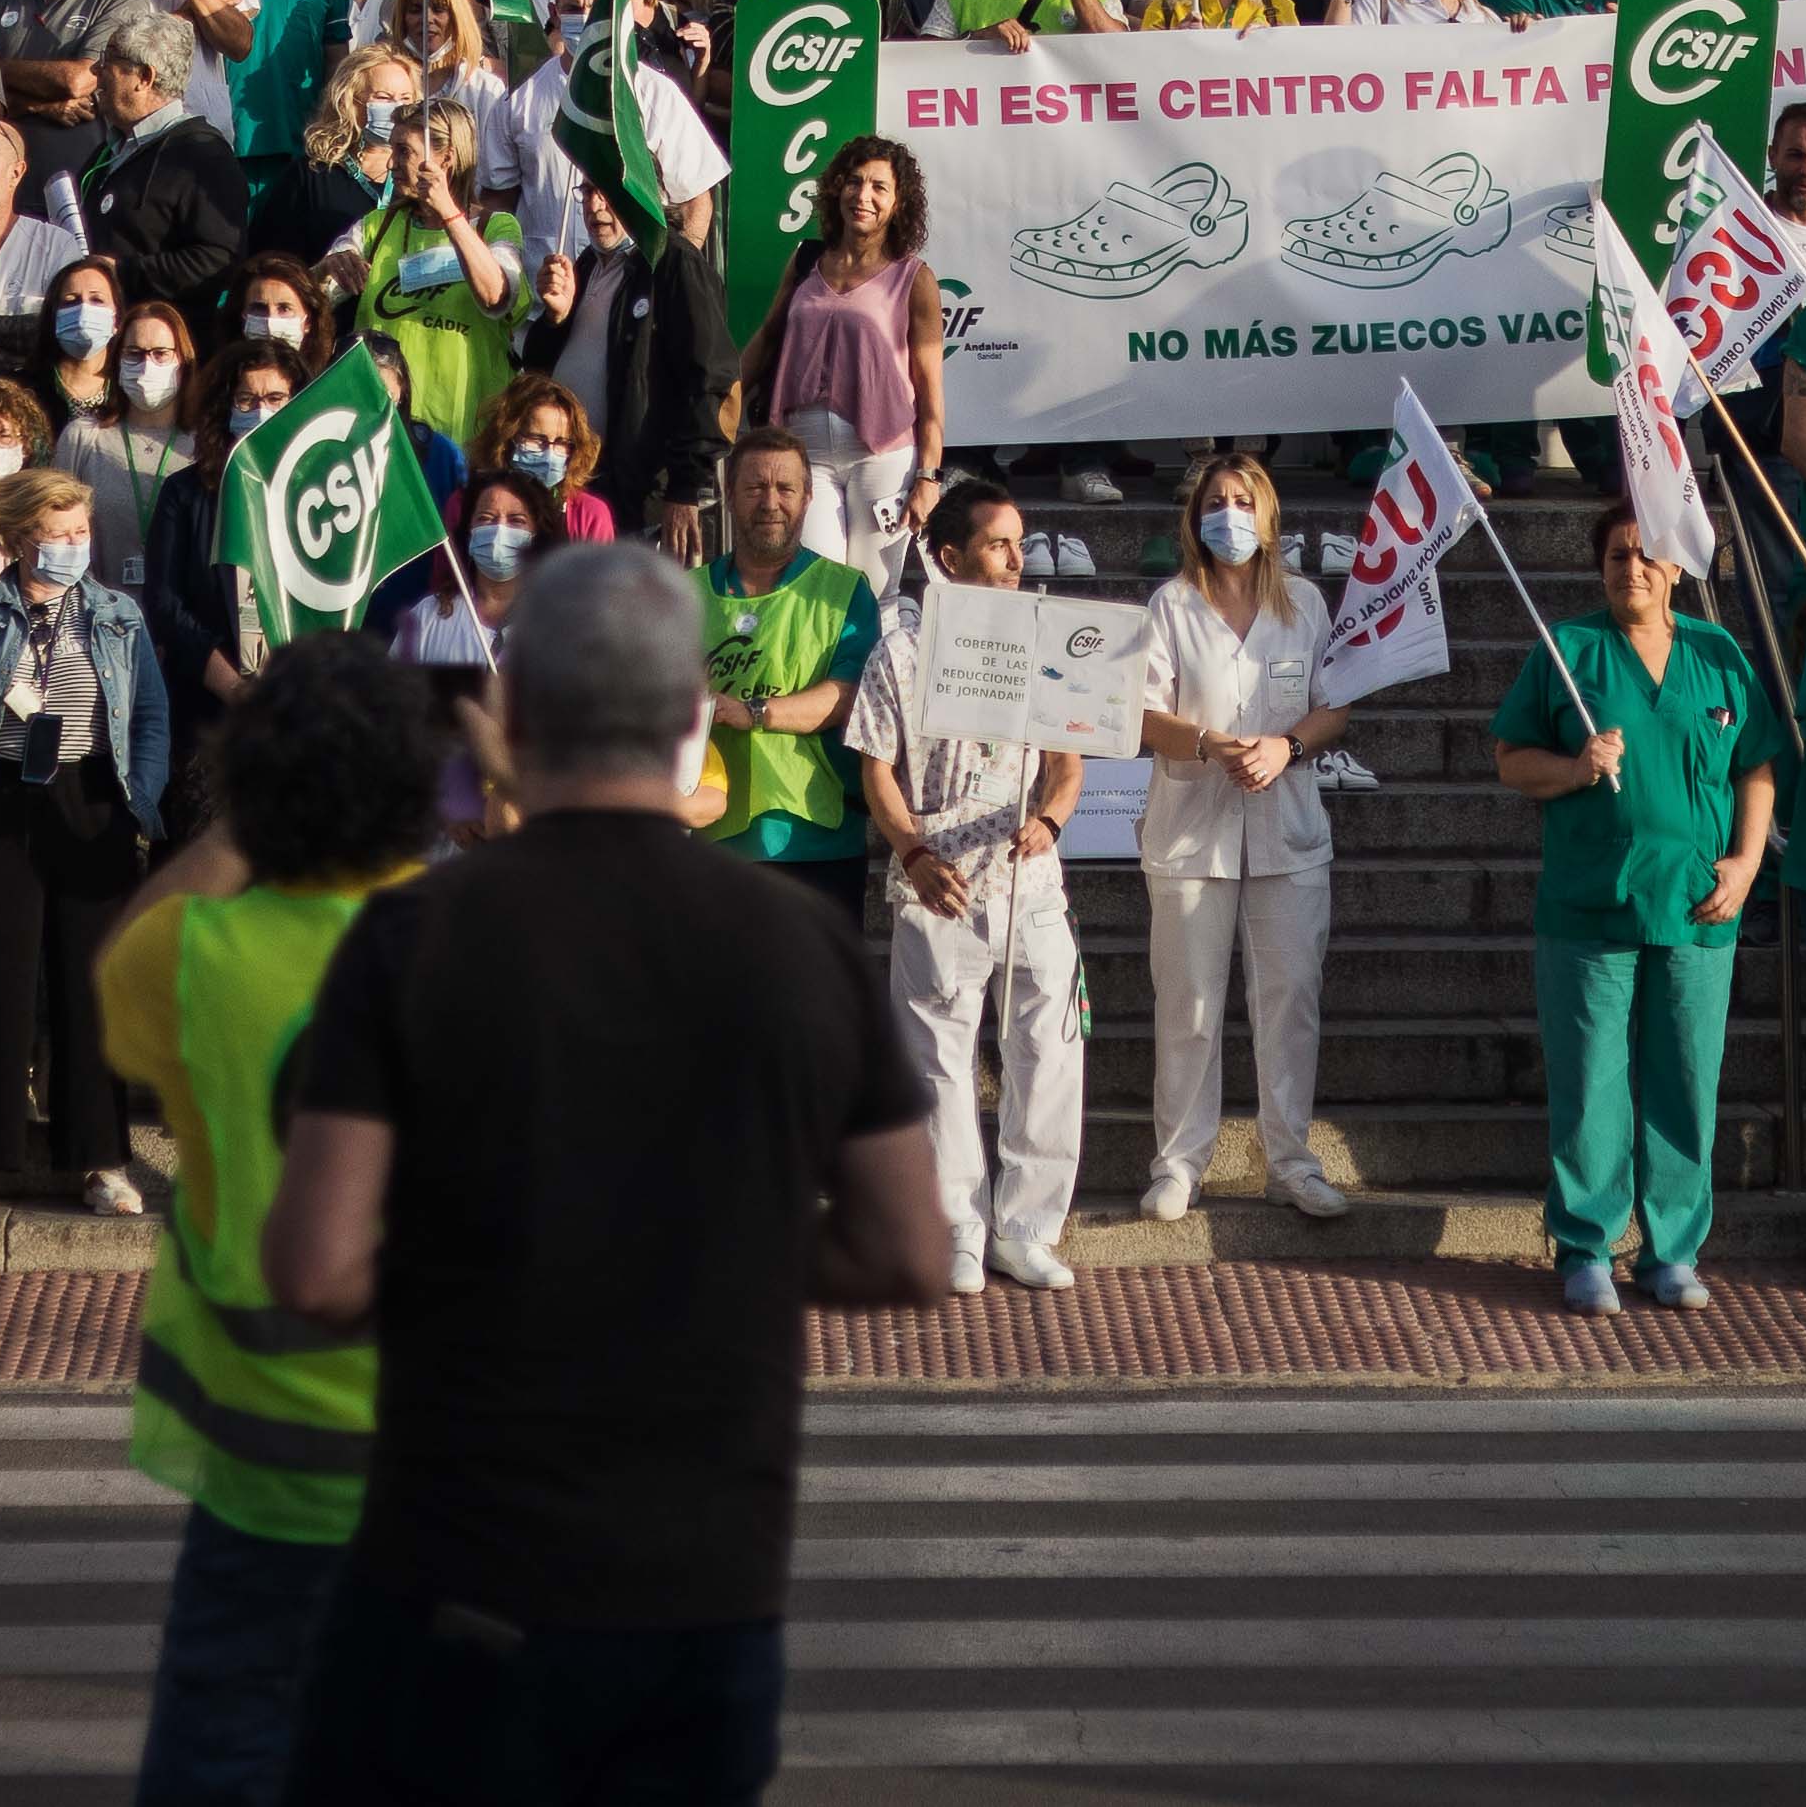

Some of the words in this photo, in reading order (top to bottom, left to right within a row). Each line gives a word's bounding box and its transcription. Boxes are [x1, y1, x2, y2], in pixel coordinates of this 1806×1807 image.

[908, 88, 979, 127] EN
[1001, 83, 1139, 124] ESTE
[1159, 73, 1385, 120] CENTRO
[1405, 65, 1568, 111] FALTA
[423, 315, 471, 336] CÁDIZ
[964, 341, 1018, 351] Andalucía
[1128, 330, 1189, 362] NO
[1205, 320, 1297, 359] MÁS
[1311, 316, 1487, 355] ZUECOS
[1624, 371, 1653, 447] Federación
[954, 637, 1026, 655] COBERTURA
[982, 656, 997, 667] DE
[1007, 659, 1028, 671] LAS
[942, 668, 1026, 687] REDUCCIONES
[741, 685, 781, 699] CDIZ
[936, 683, 952, 694] DE
[957, 685, 1025, 703] JORNADA!!!
[1074, 808, 1145, 816] PROFESIONAL
